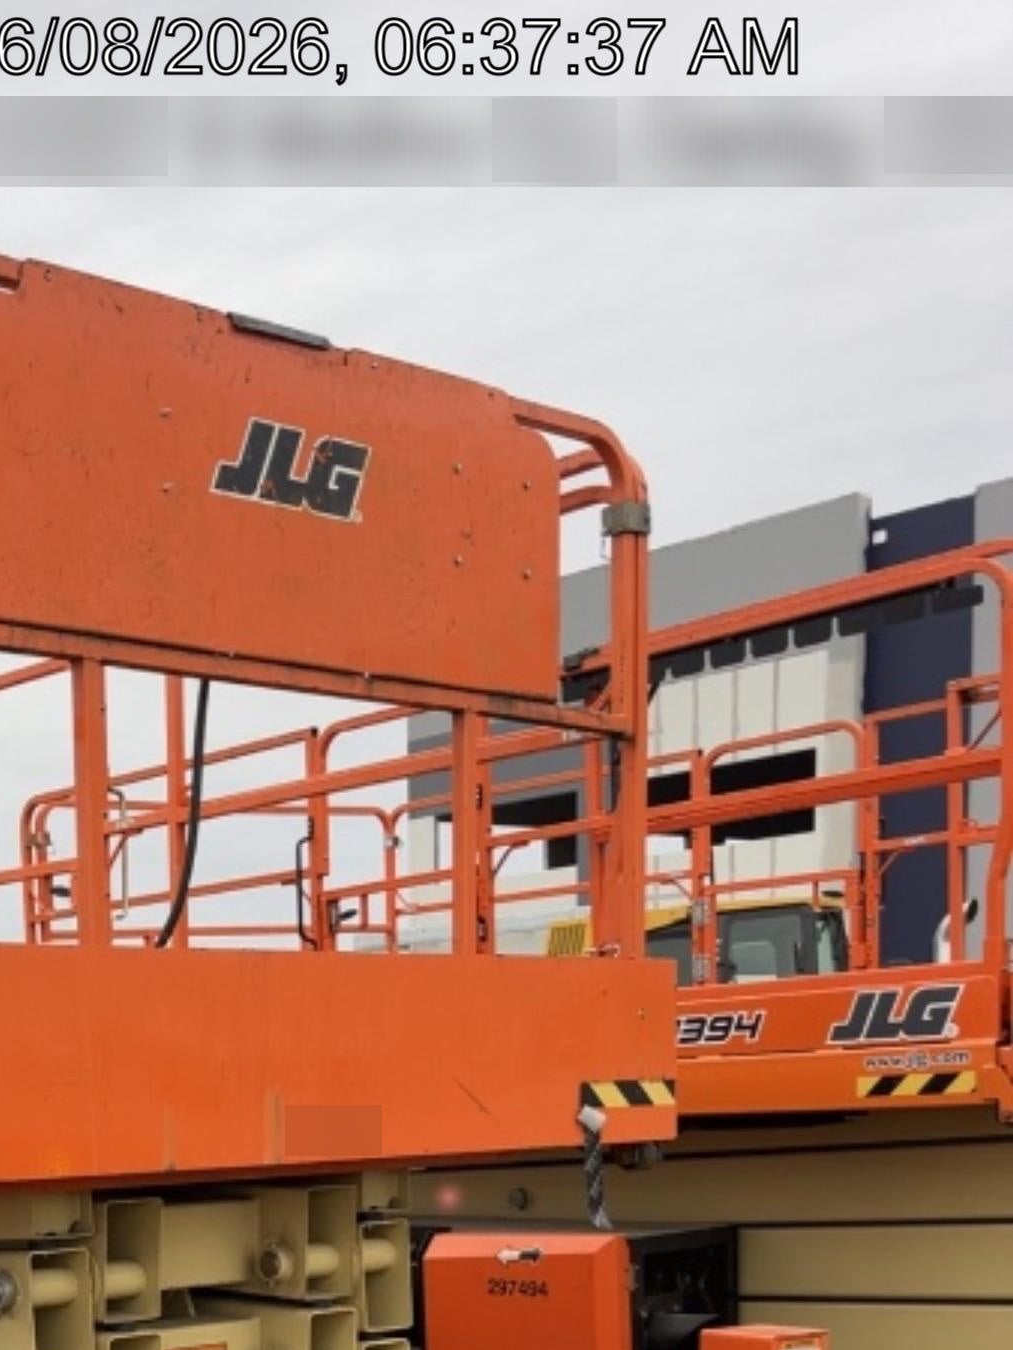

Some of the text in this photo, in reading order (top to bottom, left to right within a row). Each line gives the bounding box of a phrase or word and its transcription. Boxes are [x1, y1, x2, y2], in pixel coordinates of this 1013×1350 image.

[209, 416, 372, 524] JLG
[676, 1009, 767, 1046] 394
[825, 984, 964, 1045] JLG
